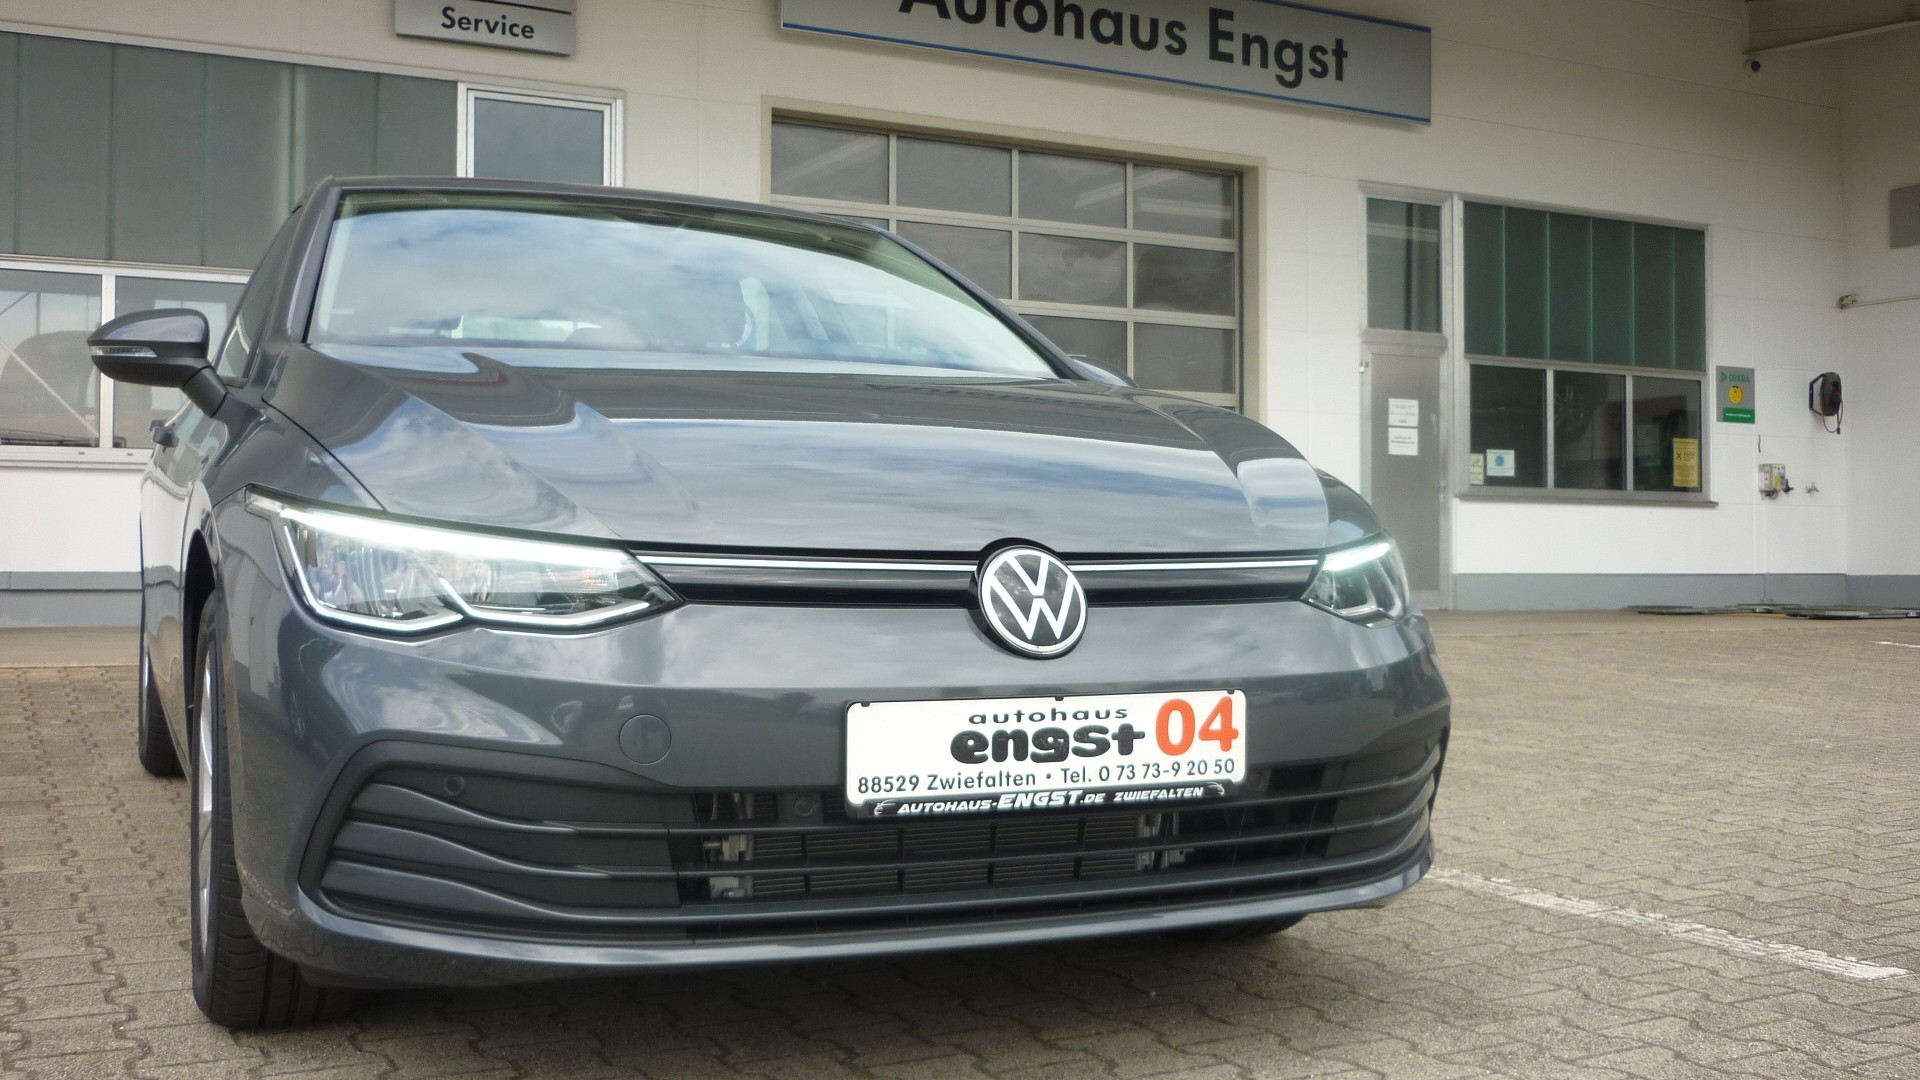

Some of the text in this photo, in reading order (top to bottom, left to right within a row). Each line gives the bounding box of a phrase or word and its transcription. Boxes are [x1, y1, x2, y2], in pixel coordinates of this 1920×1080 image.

[441, 6, 535, 39] Service
[1208, 9, 1348, 89] Engst
[968, 706, 1128, 725] autohaus
[1155, 696, 1239, 756] 04
[950, 723, 1145, 764] engst
[858, 774, 920, 794] 88529
[927, 770, 1036, 791] Zwiefalten
[1061, 765, 1092, 784] Tel.
[1099, 765, 1110, 782] 0
[1116, 764, 1136, 780] 73
[1187, 759, 1208, 776] 20
[1214, 757, 1235, 775] 50
[1113, 787, 1204, 802] ZWIEFALTEN
